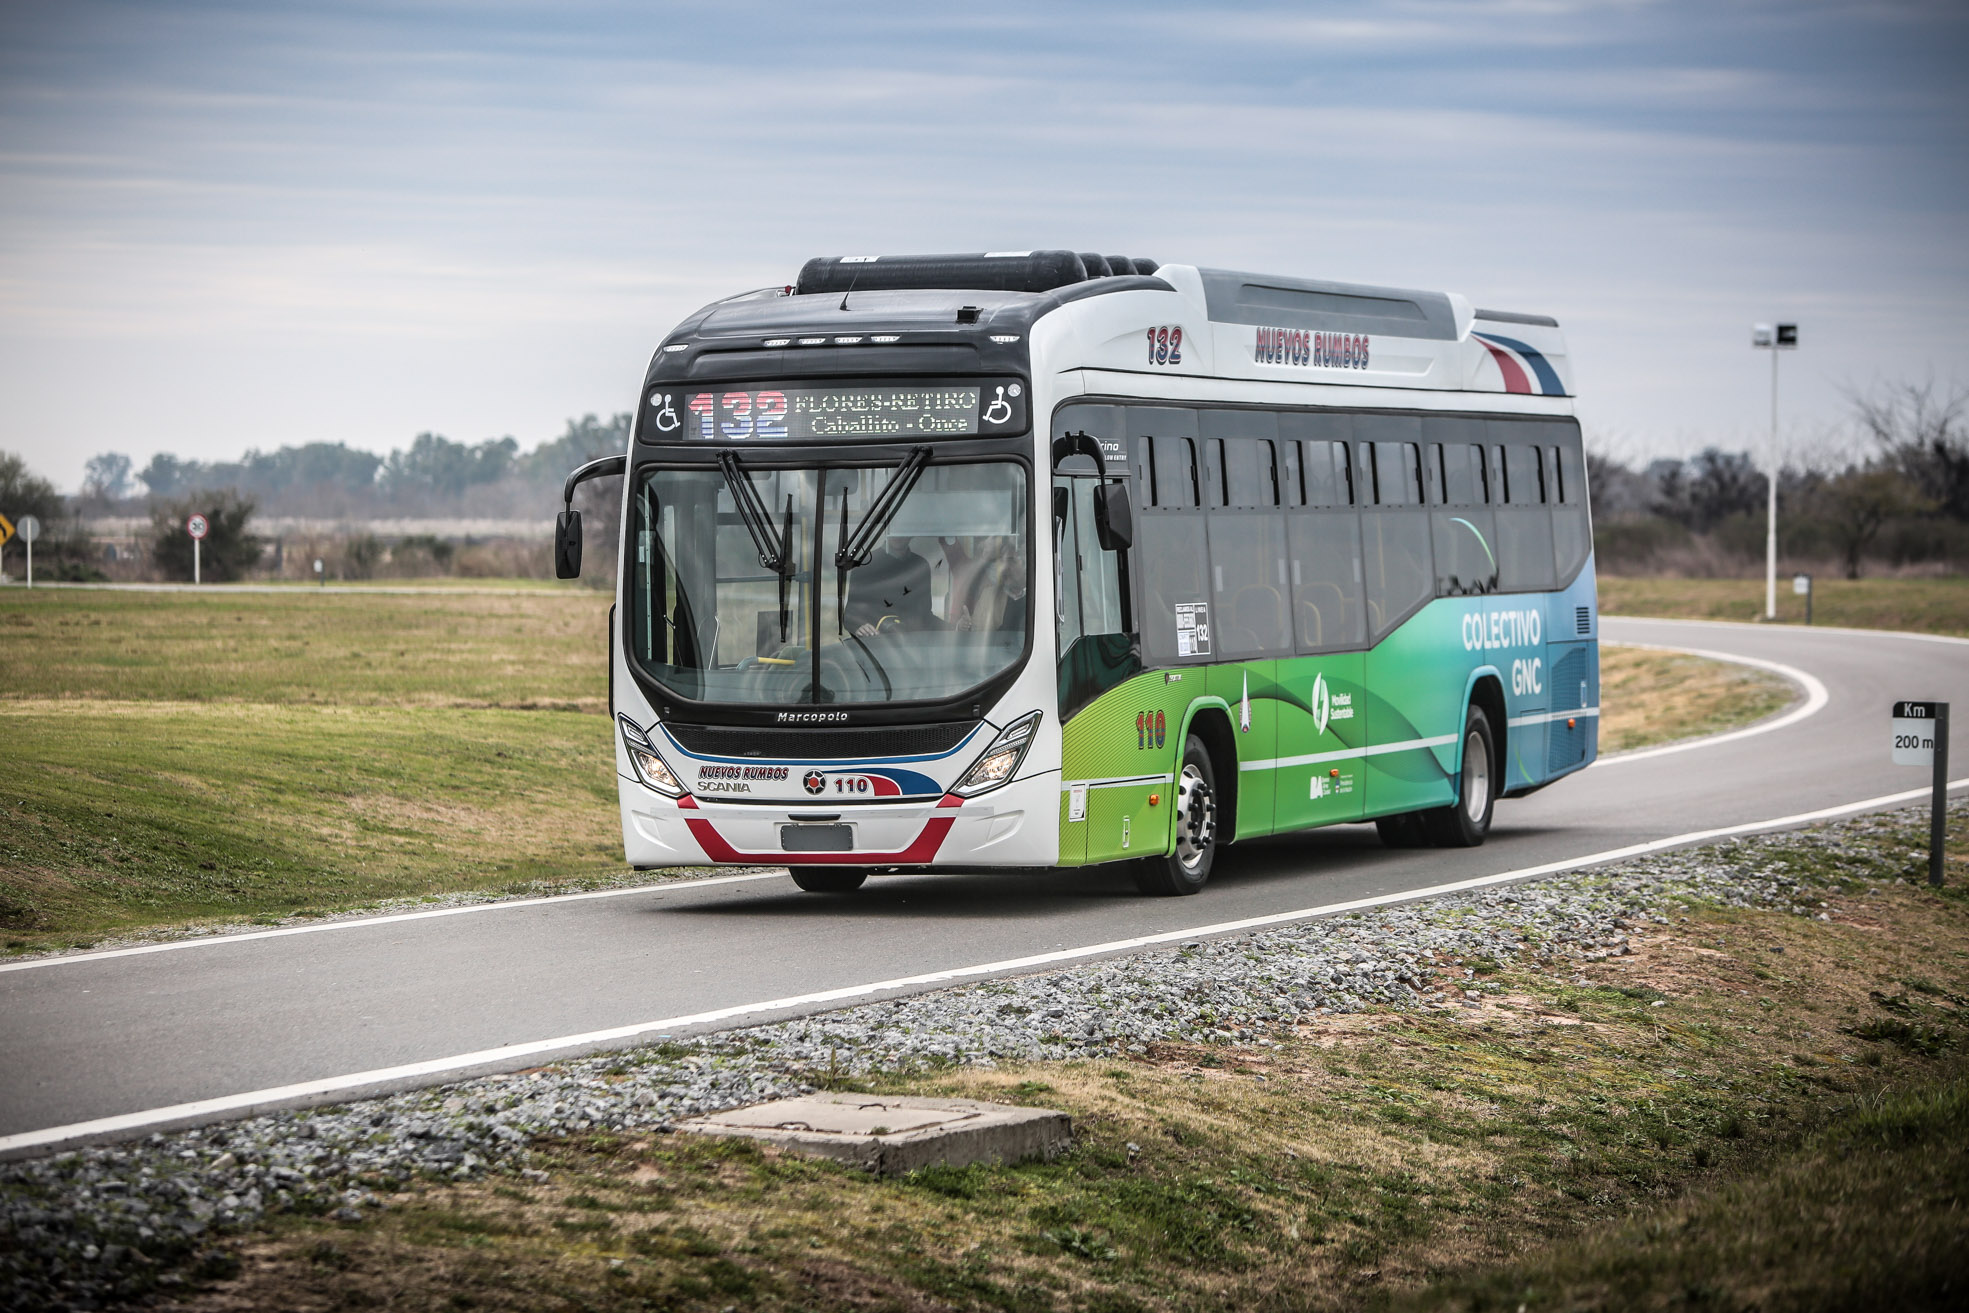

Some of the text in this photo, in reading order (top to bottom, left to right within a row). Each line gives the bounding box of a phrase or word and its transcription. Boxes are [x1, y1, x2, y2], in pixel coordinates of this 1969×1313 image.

[1147, 326, 1182, 365] 132
[1254, 327, 1369, 370] NUEVOS RUMBOS
[795, 392, 976, 413] FLORES-RETIRO
[688, 391, 788, 440] 132
[918, 413, 968, 432] Once
[1197, 624, 1208, 641] 132
[1462, 609, 1541, 651] COLECTIVO
[1512, 657, 1542, 696] GNC
[777, 711, 848, 722] Marcopolo
[1904, 703, 1925, 717] Km
[1136, 710, 1166, 749] 110
[1895, 735, 1934, 749] 200 m
[698, 766, 789, 781] NUEVOS RUMBOS
[697, 781, 752, 793] SCANIA
[833, 777, 869, 794] 110
